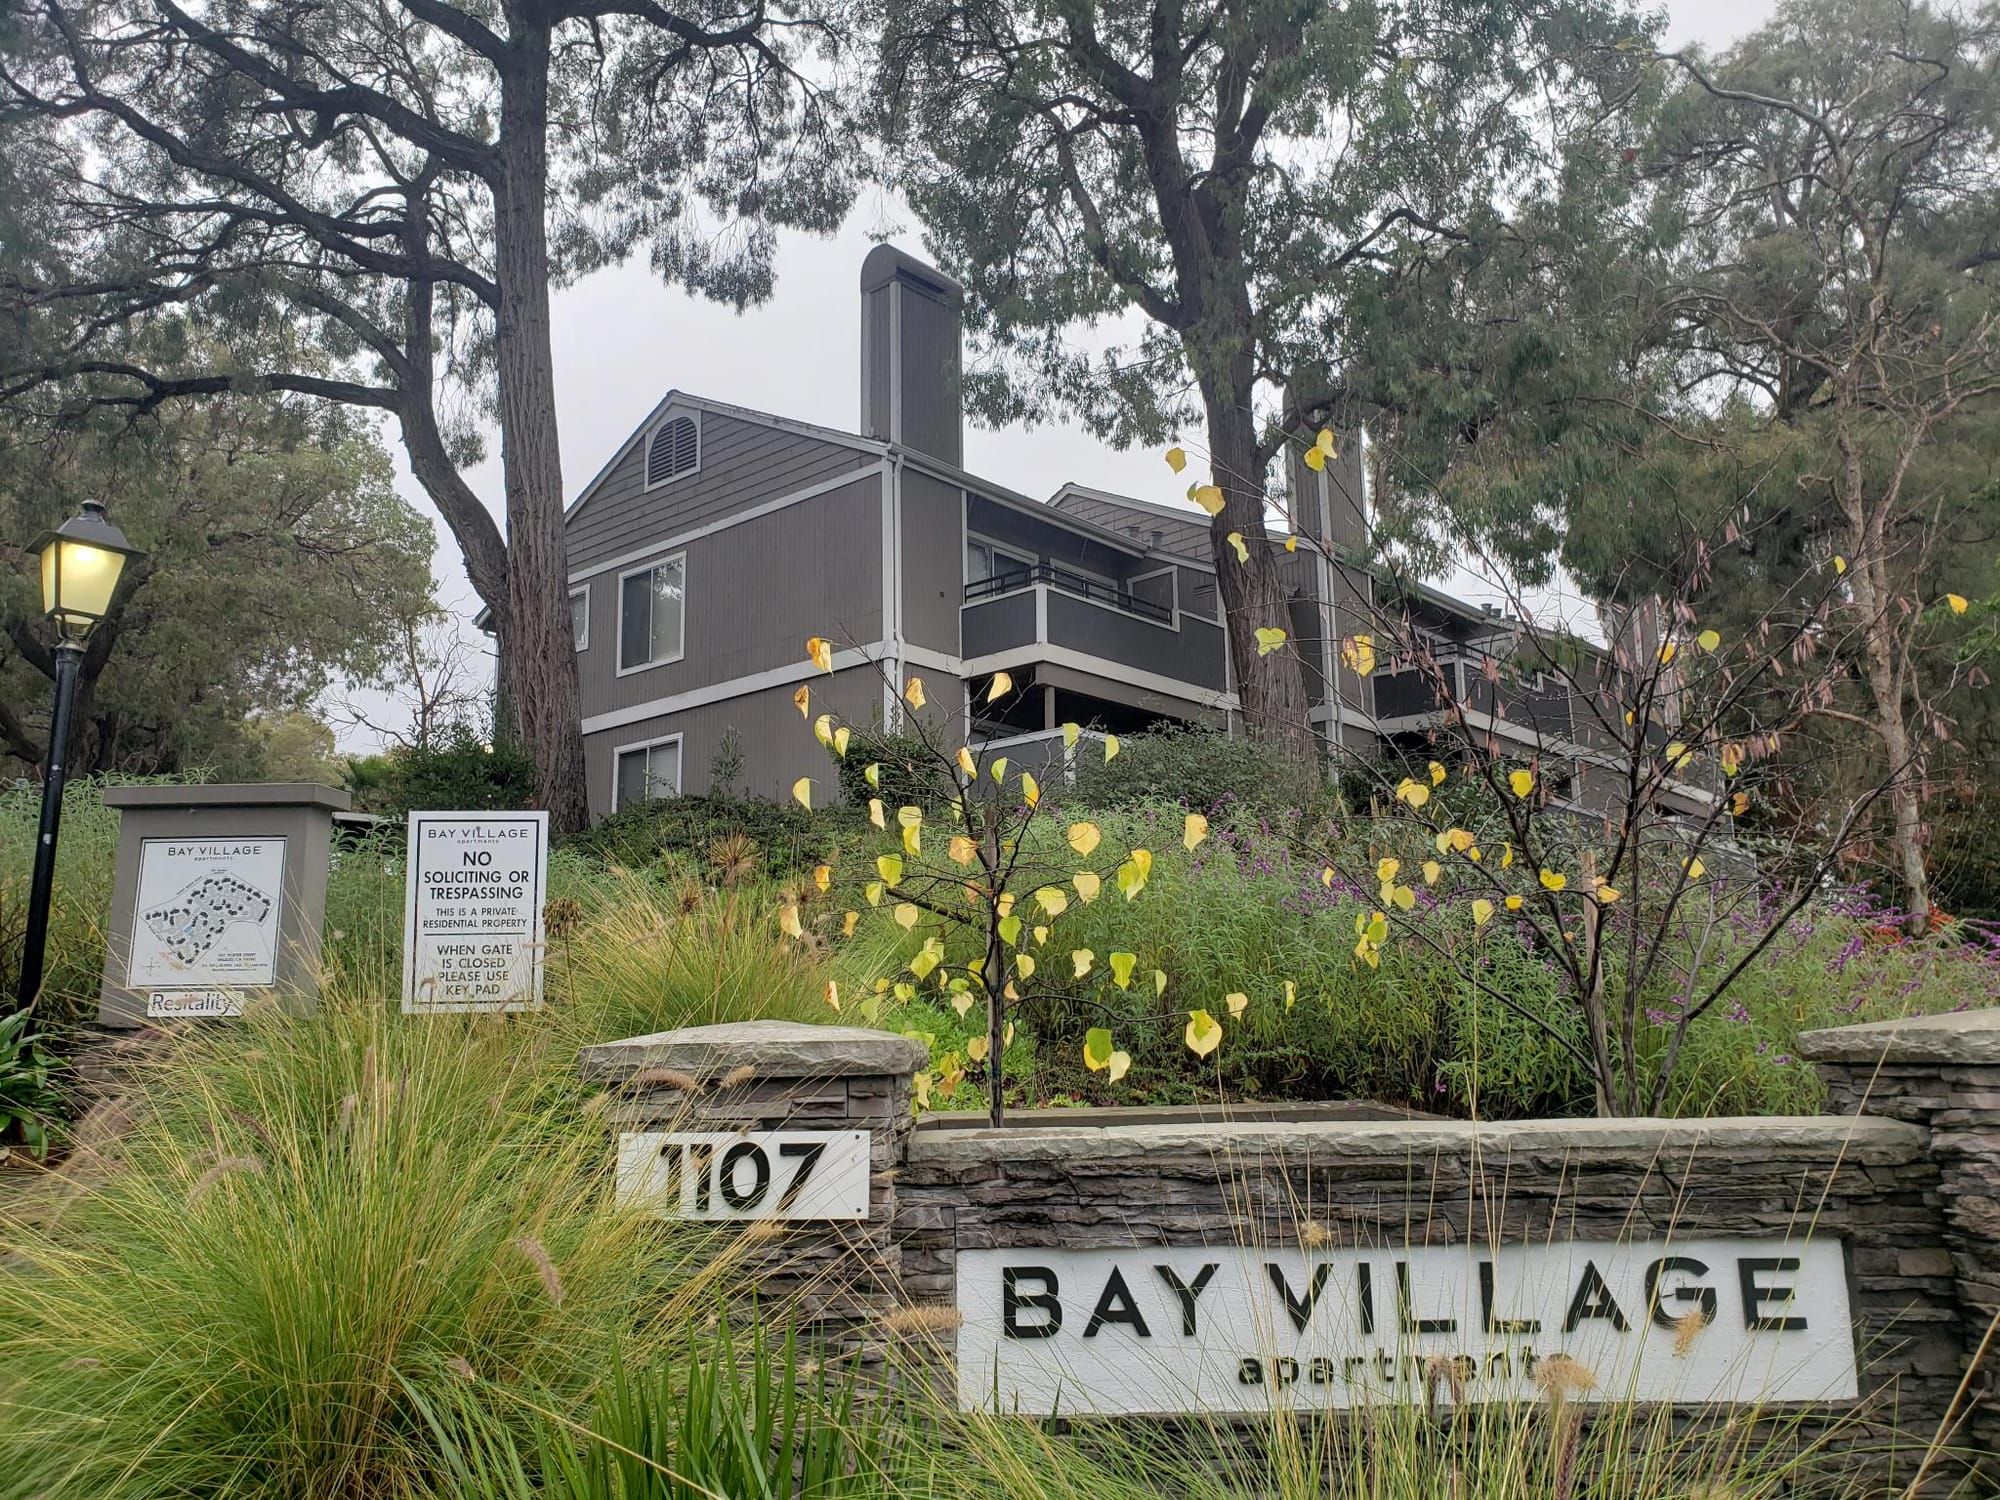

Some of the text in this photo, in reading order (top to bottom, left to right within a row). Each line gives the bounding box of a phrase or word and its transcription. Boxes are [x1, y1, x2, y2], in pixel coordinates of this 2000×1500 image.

[428, 828, 529, 839] BAY VILLAGE
[168, 845, 262, 856] BAY VILLAGE
[463, 851, 492, 866] NO
[424, 870, 529, 883] SOLICITING OR
[430, 886, 523, 900] TRESPASSING
[436, 907, 517, 916] THIS IS A PRIVATE
[423, 918, 528, 928] RESIDENTIAL PROPERTY
[437, 944, 513, 955] WHEN GATE
[442, 958, 505, 968] IS CLOSED
[439, 971, 509, 982] PLEASE USE
[446, 984, 500, 995] KEY PAD
[660, 1141, 828, 1211] 1107
[1002, 1256, 1809, 1338] BAY VILLAGE
